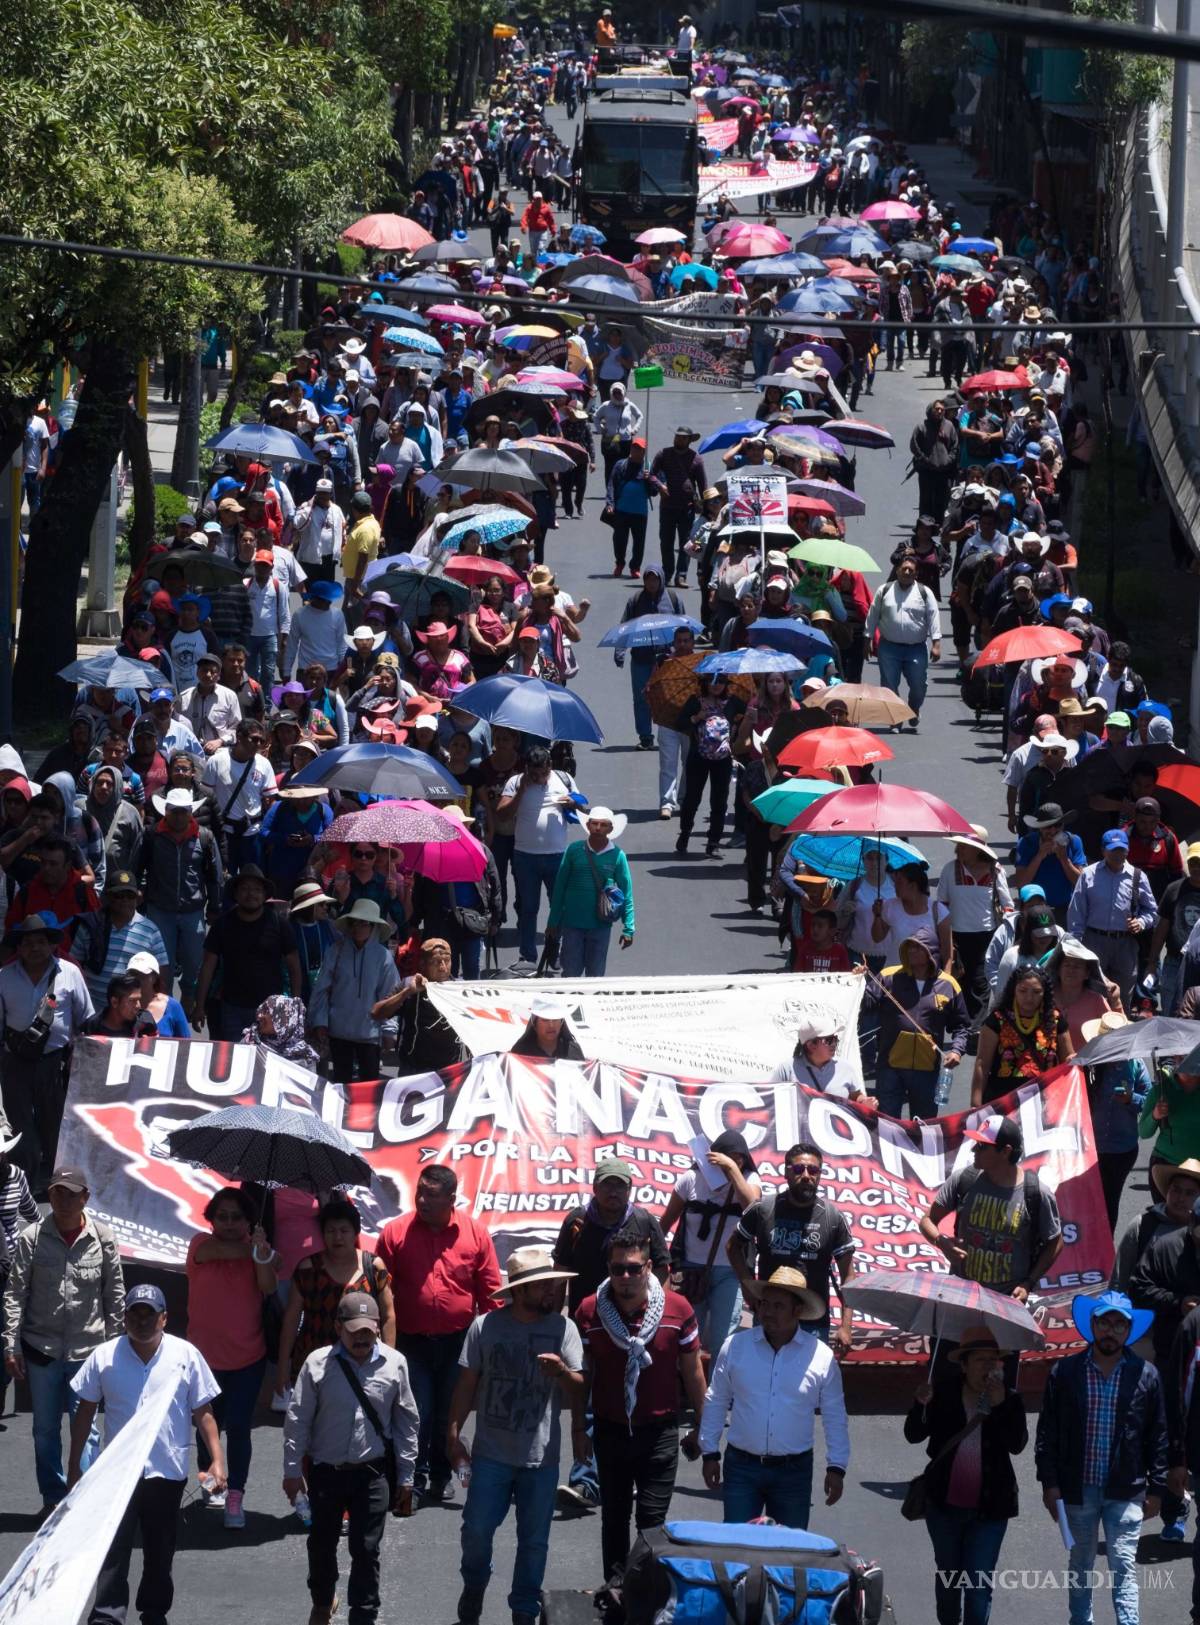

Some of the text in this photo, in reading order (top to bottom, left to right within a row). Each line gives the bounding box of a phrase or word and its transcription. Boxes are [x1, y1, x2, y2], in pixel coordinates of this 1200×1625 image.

[106, 1039, 519, 1148] HUELGA
[452, 1139, 517, 1160] POR
[530, 1144, 572, 1162] LA
[872, 1170, 909, 1199] DE
[108, 1224, 133, 1236] DE
[969, 1193, 1008, 1233] GUNS
[116, 1233, 140, 1245] DE
[147, 1243, 173, 1256] LA
[965, 1245, 1013, 1283] ROSES
